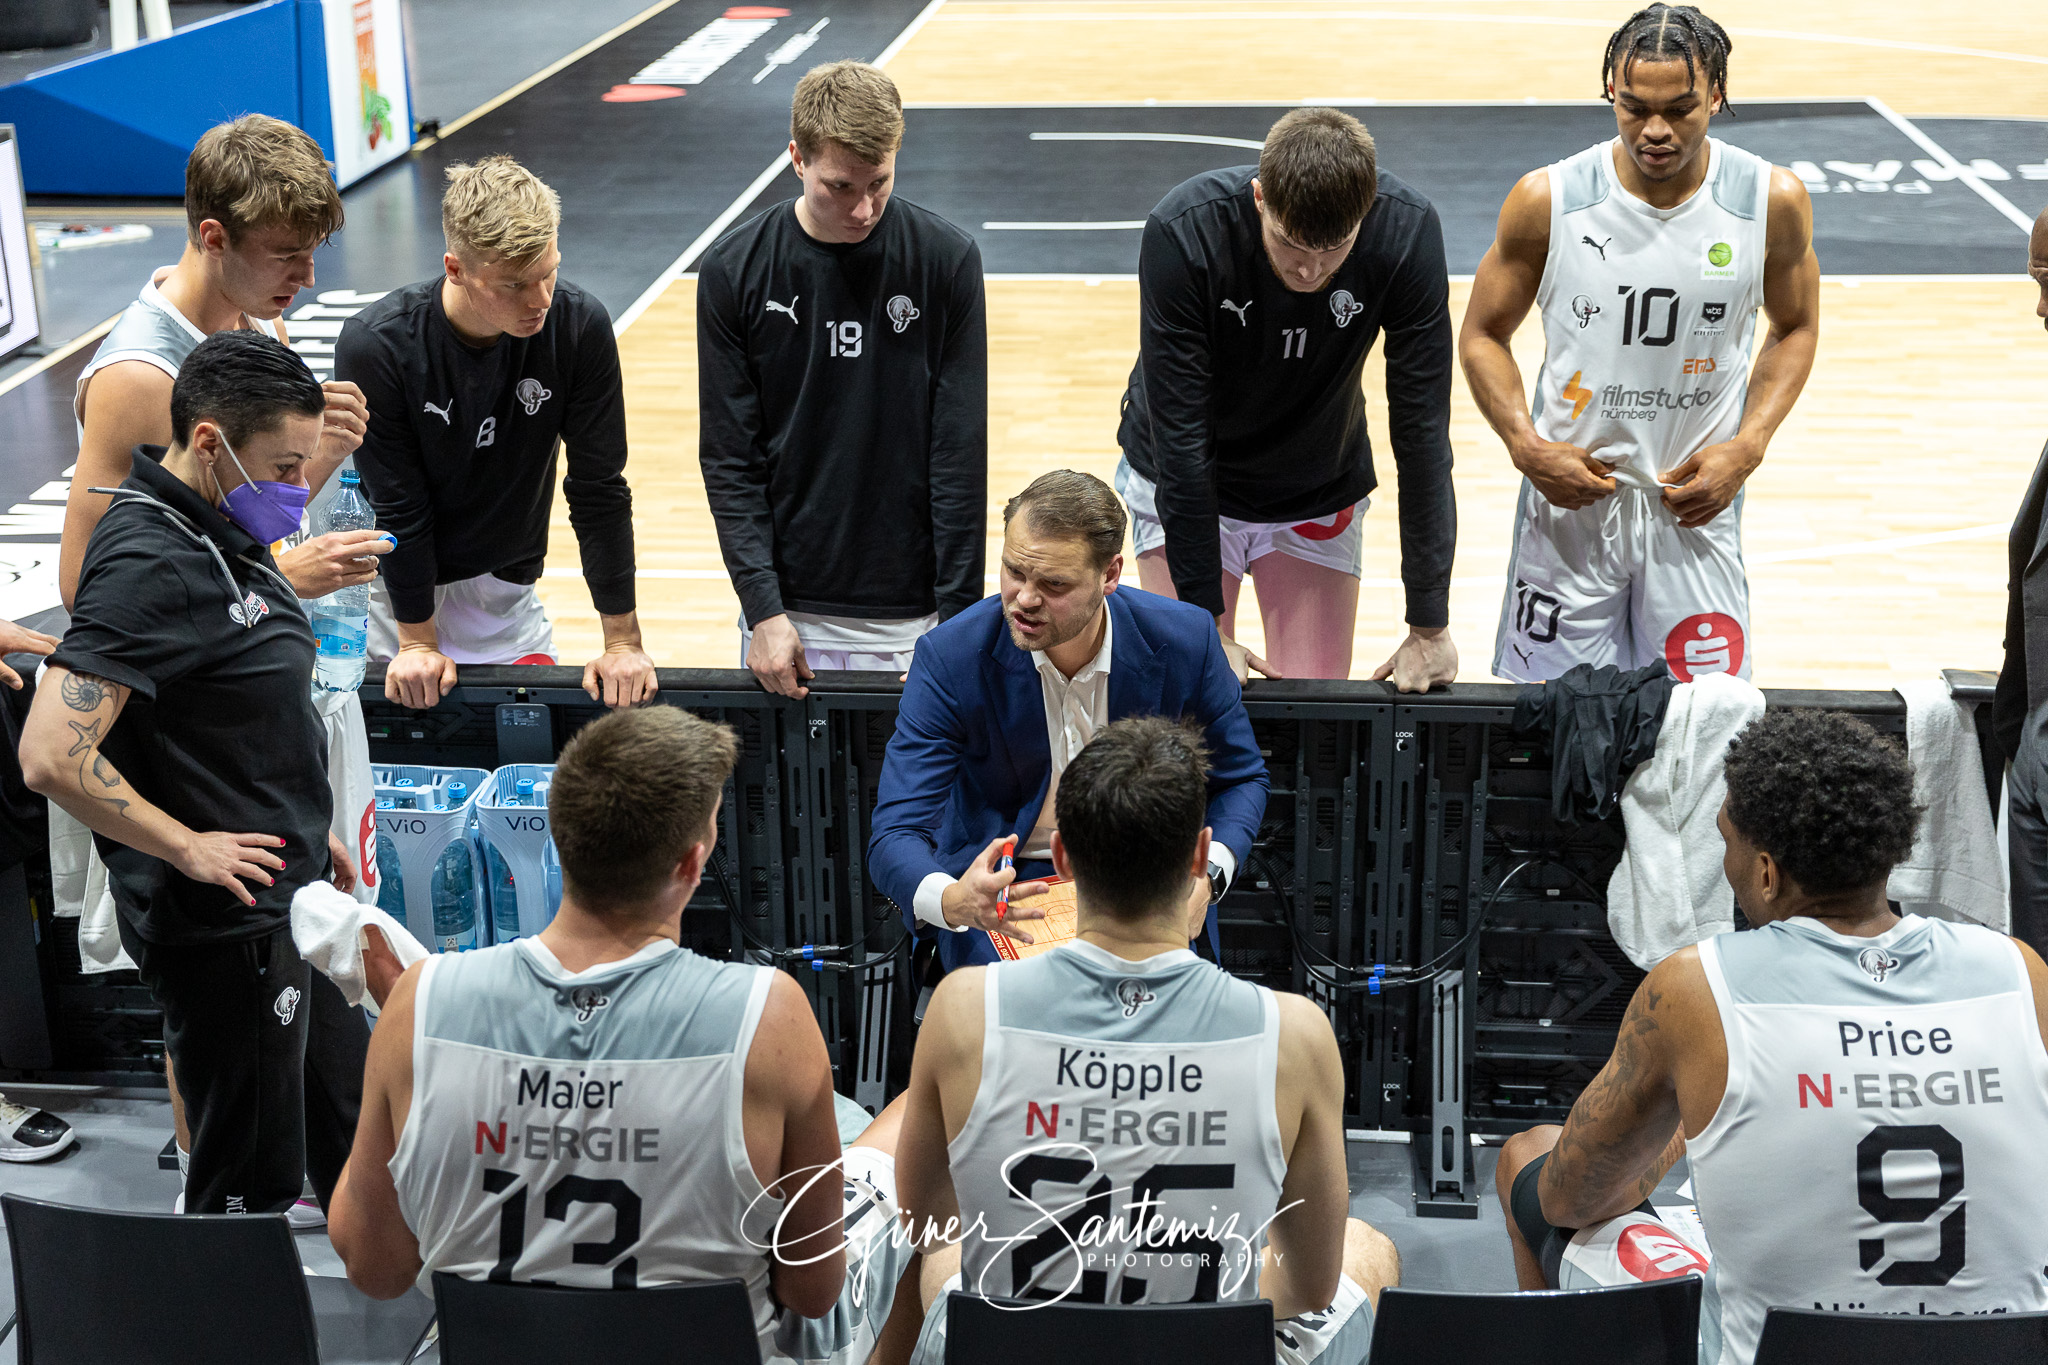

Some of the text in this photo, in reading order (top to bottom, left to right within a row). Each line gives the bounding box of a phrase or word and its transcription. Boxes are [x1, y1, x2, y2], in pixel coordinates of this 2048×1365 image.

[1618, 285, 1681, 347] 10
[826, 321, 862, 358] 19
[1282, 327, 1308, 359] 11
[1600, 408, 1657, 422] nürnberg
[1515, 579, 1562, 643] 10
[1838, 1020, 1953, 1057] Price
[517, 1068, 623, 1109] Maier
[1056, 1047, 1203, 1100] Köpple
[1856, 1124, 1967, 1287] 9
